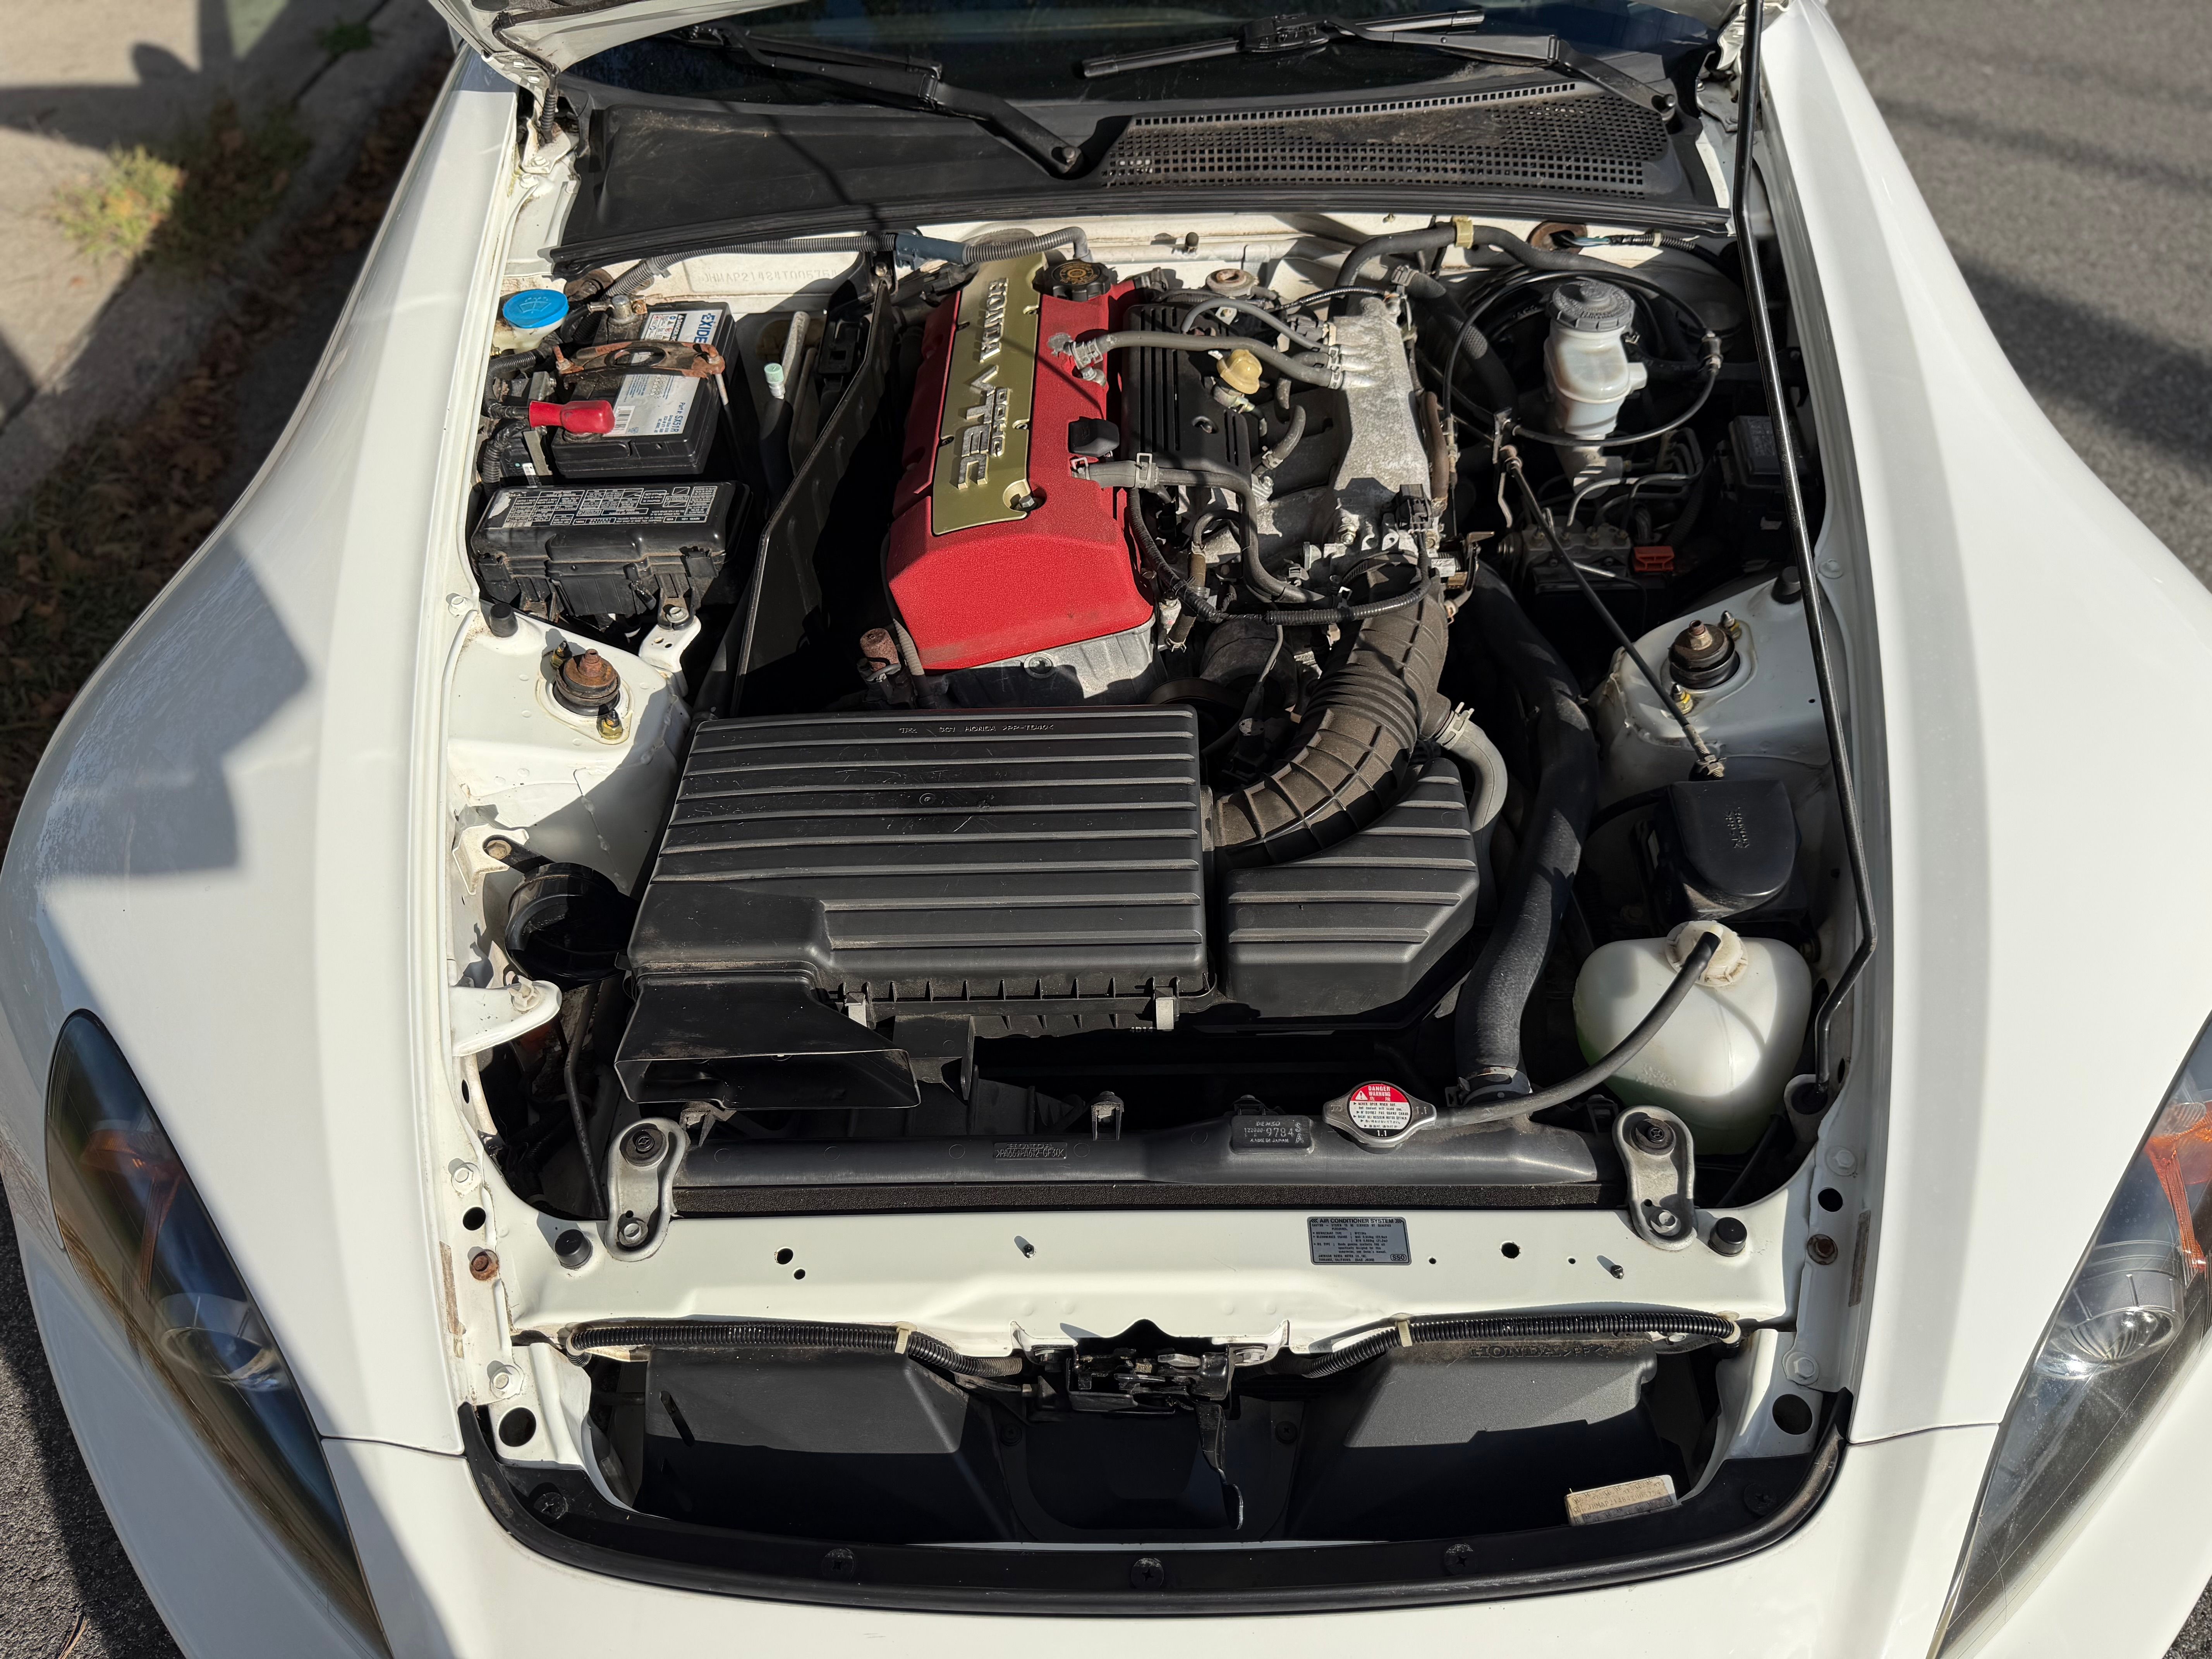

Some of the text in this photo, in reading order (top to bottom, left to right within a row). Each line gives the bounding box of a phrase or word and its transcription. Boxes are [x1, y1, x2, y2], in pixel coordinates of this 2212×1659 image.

[694, 313, 716, 343] EXIDE
[979, 277, 1008, 363] HONDA
[670, 415, 683, 433] SX51R
[958, 365, 999, 490] VTEC
[990, 387, 1010, 457] DOHC
[1470, 1346, 1561, 1358] HONDA
